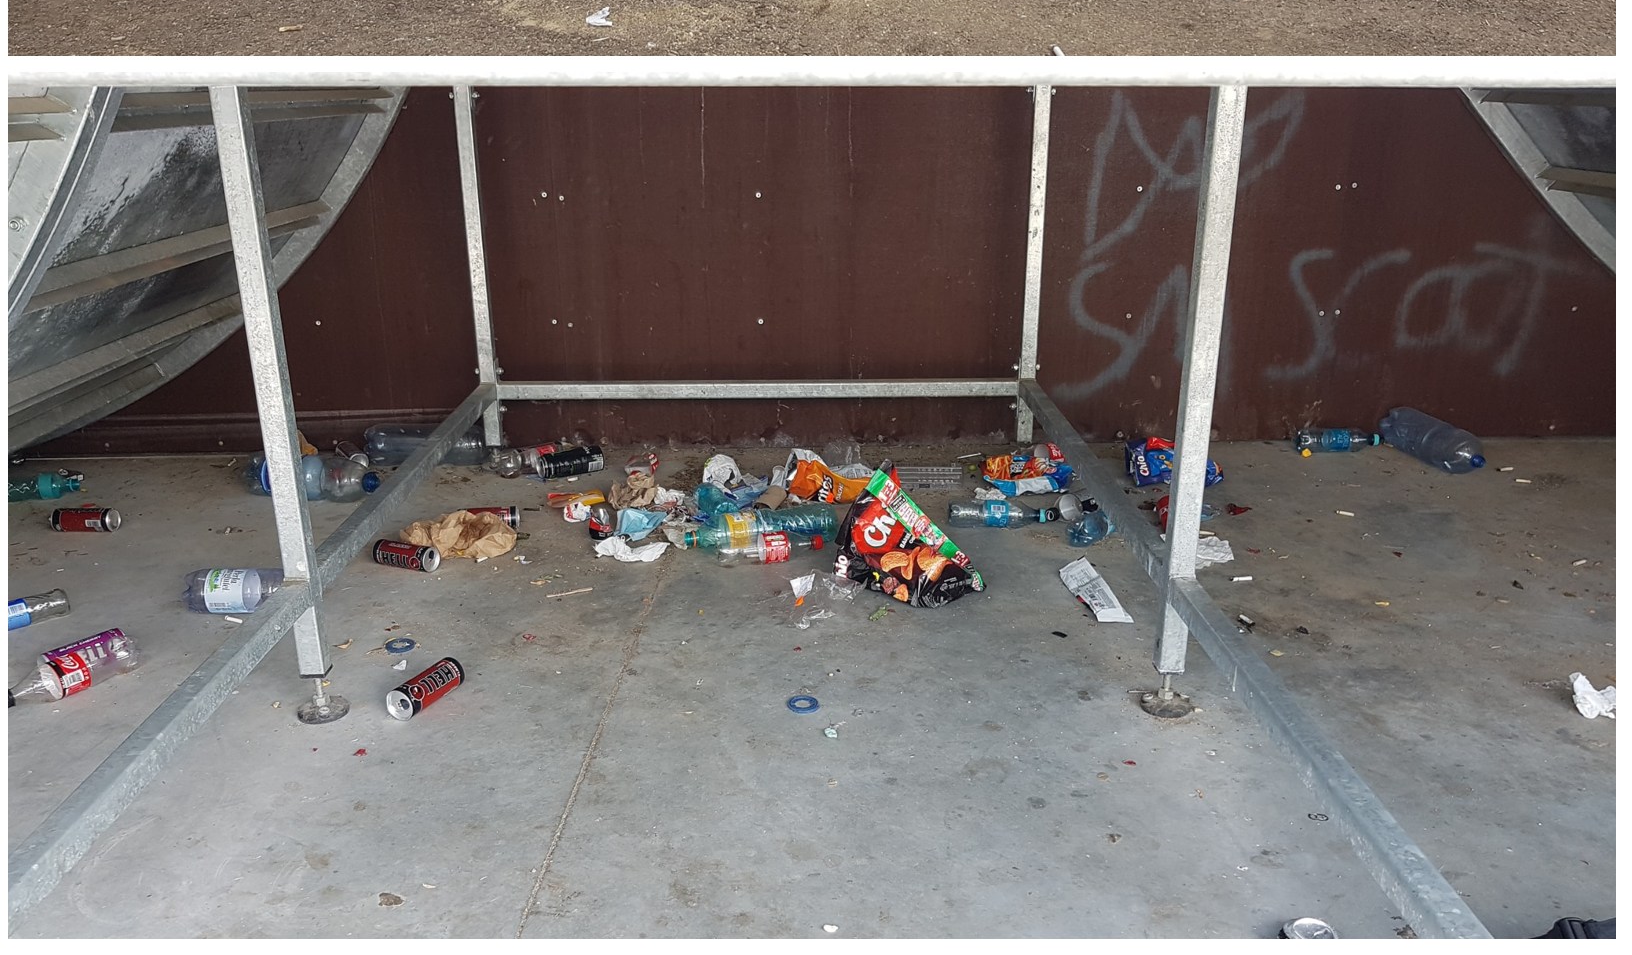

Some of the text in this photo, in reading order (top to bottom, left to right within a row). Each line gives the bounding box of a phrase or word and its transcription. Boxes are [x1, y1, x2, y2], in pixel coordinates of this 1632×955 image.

[1137, 455, 1150, 477] Chio
[818, 474, 833, 502] ritos
[863, 513, 898, 548] Ch
[380, 550, 410, 569] HELL
[835, 555, 848, 578] hio
[420, 665, 454, 695] HELL
